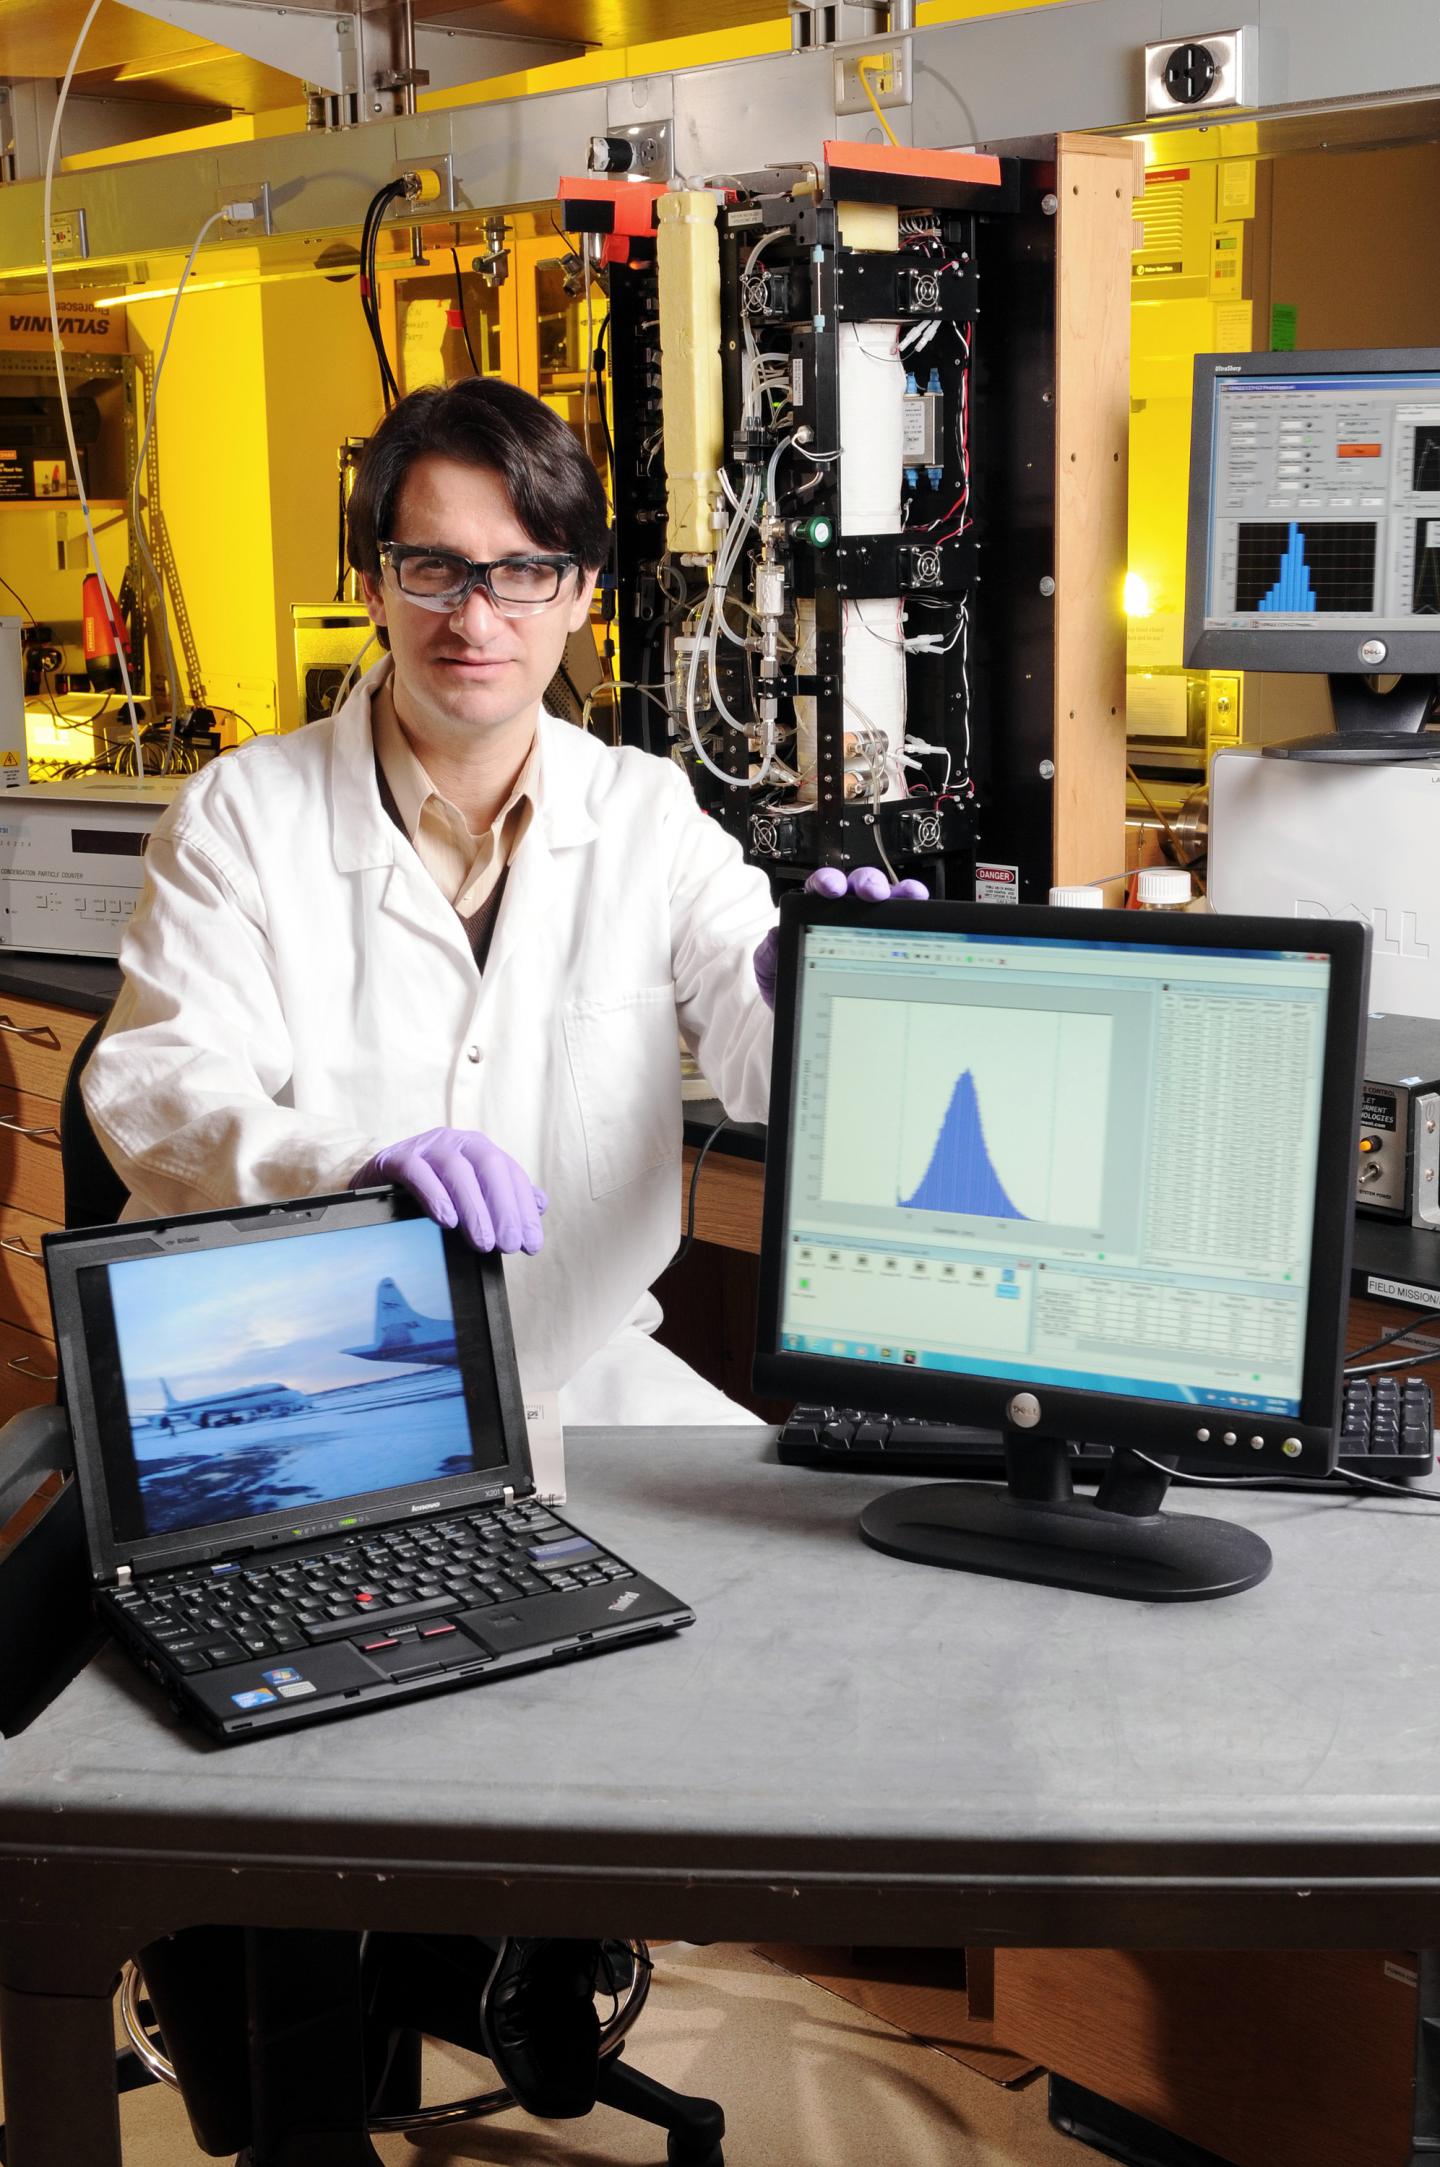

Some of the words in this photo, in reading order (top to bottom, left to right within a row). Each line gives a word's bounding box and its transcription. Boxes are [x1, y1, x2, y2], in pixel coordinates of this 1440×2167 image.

[10, 315, 110, 334] SYLVANIA
[979, 870, 1010, 881] DANGER
[1368, 1087, 1395, 1096] CONTROL
[1369, 1280, 1396, 1294] FIELD
[1397, 1286, 1440, 1305] MISSION/
[485, 1488, 501, 1497] X201
[411, 1502, 441, 1513] lenovo
